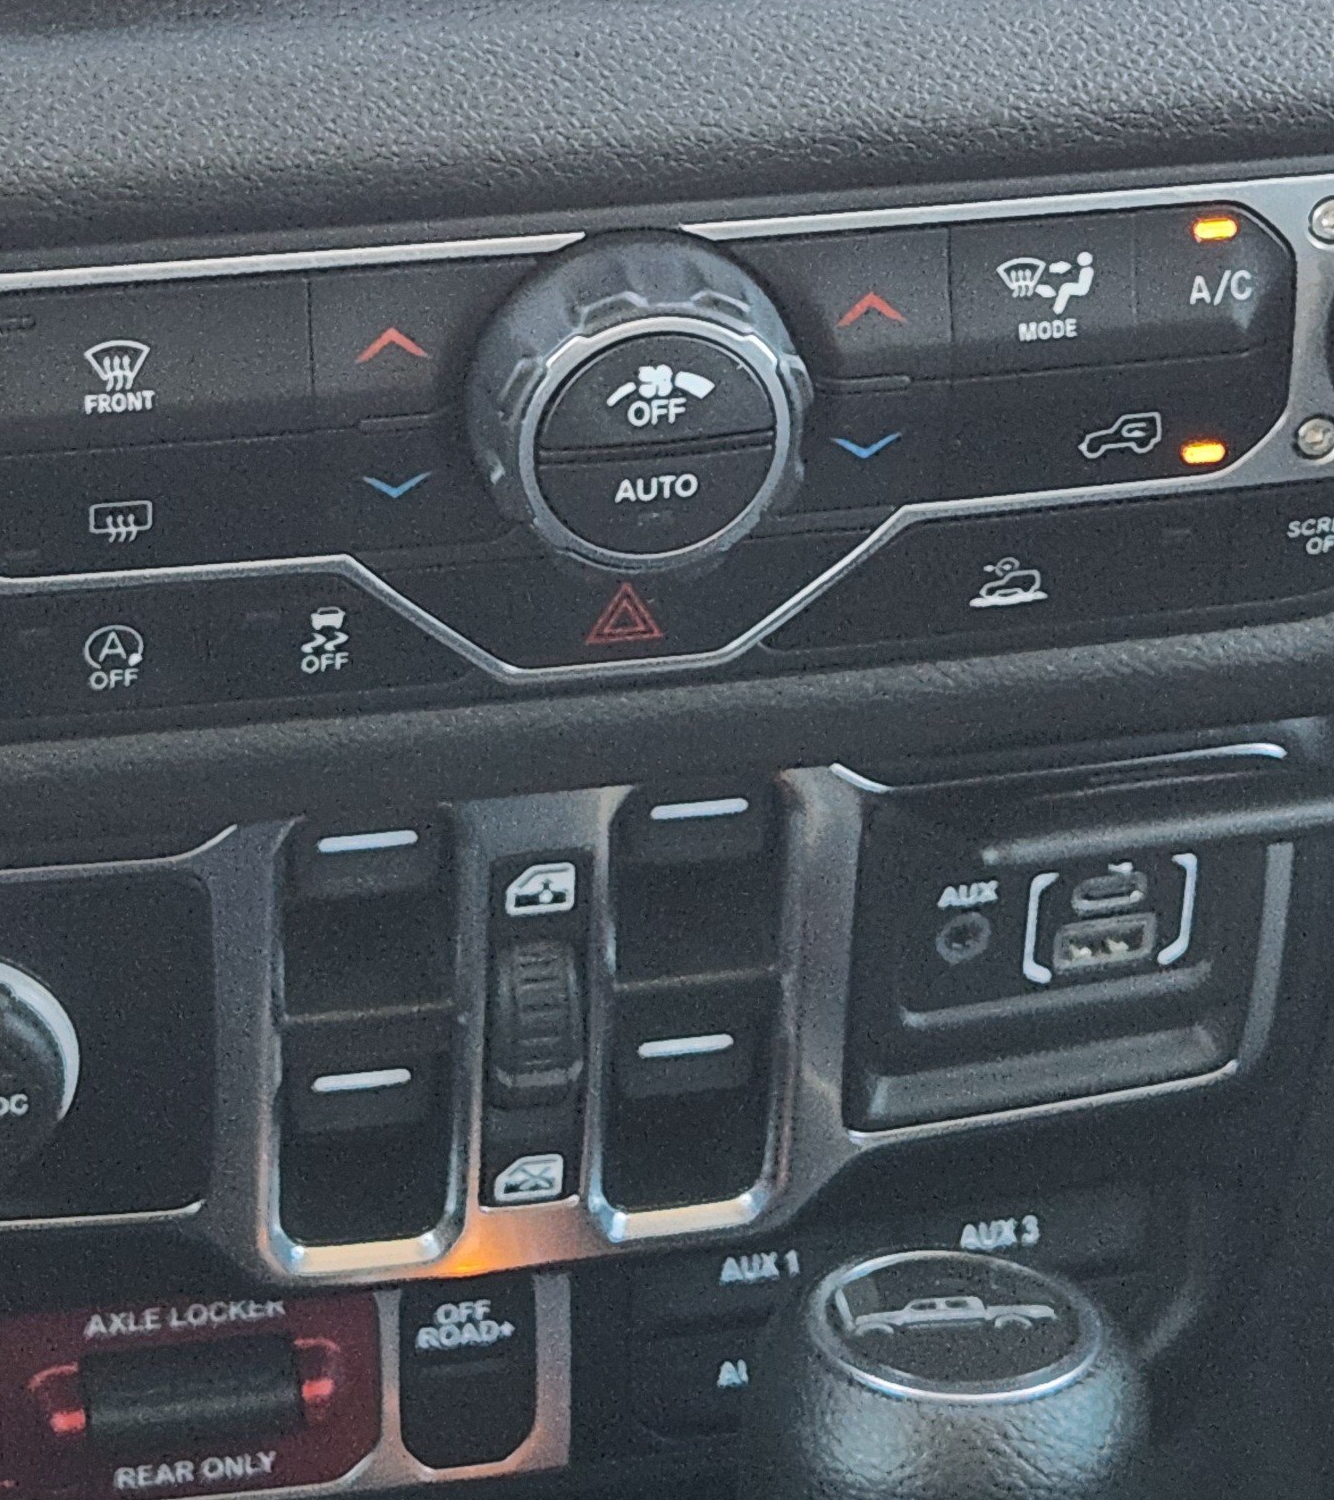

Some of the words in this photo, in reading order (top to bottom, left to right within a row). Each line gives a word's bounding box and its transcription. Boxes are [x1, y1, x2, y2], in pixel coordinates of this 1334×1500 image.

[1189, 270, 1253, 305] A/C
[1018, 319, 1078, 343] MODE
[84, 389, 155, 415] FRONT
[627, 397, 687, 427] OFF
[614, 473, 699, 504] AUTO
[300, 648, 349, 675] OFF
[89, 667, 140, 692] OFF
[937, 880, 999, 909] AUX
[960, 1220, 1017, 1250] AUX
[1021, 1215, 1041, 1246] 3
[719, 1253, 780, 1286] AUX
[784, 1249, 801, 1279] 1
[83, 1307, 164, 1340] AXLE
[168, 1298, 287, 1330] LOCKER
[433, 1299, 493, 1326] OFF
[114, 1462, 197, 1491] REAR
[201, 1449, 279, 1483] ONLY
